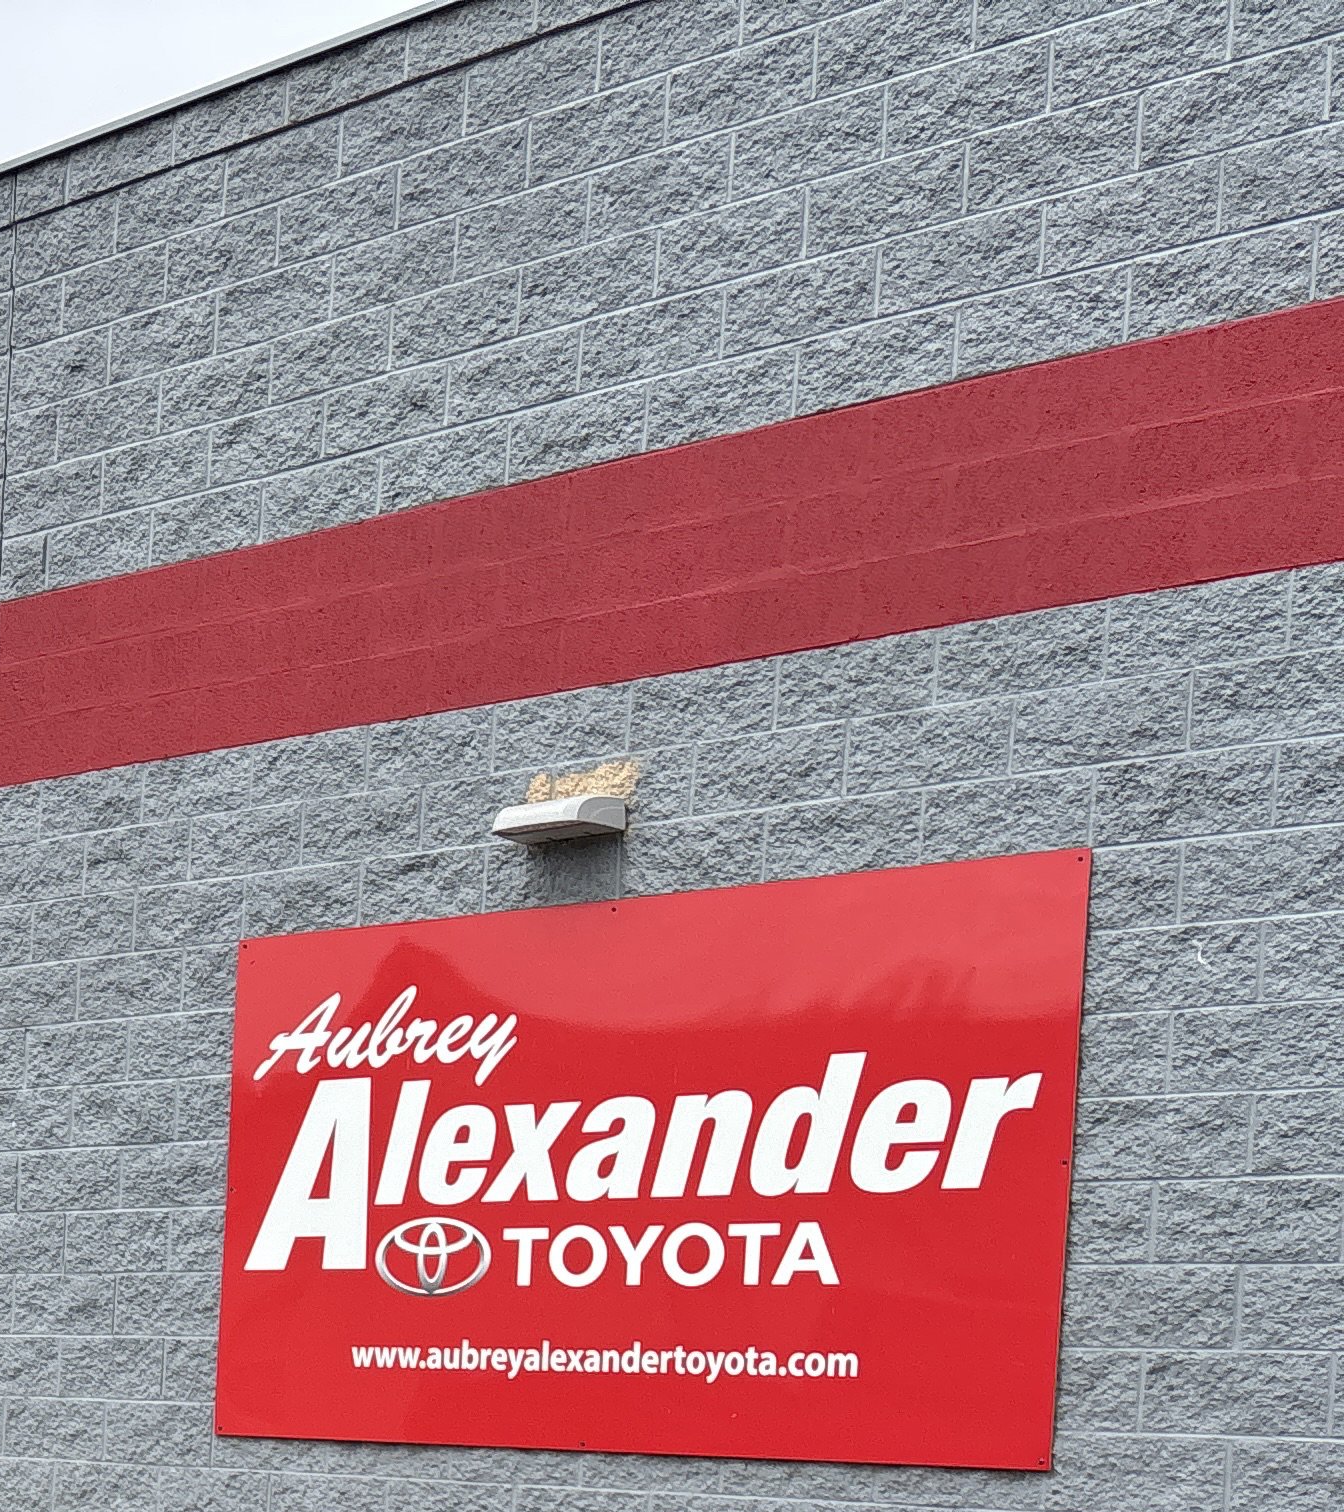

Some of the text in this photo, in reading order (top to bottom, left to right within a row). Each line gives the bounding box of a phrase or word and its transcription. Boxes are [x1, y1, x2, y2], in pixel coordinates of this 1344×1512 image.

[253, 985, 518, 1087] Aubrey
[243, 1051, 1043, 1271] Alexander
[502, 1221, 840, 1288] TOYOTA
[351, 1339, 860, 1384] www.aubreyalexandertoyota.com
